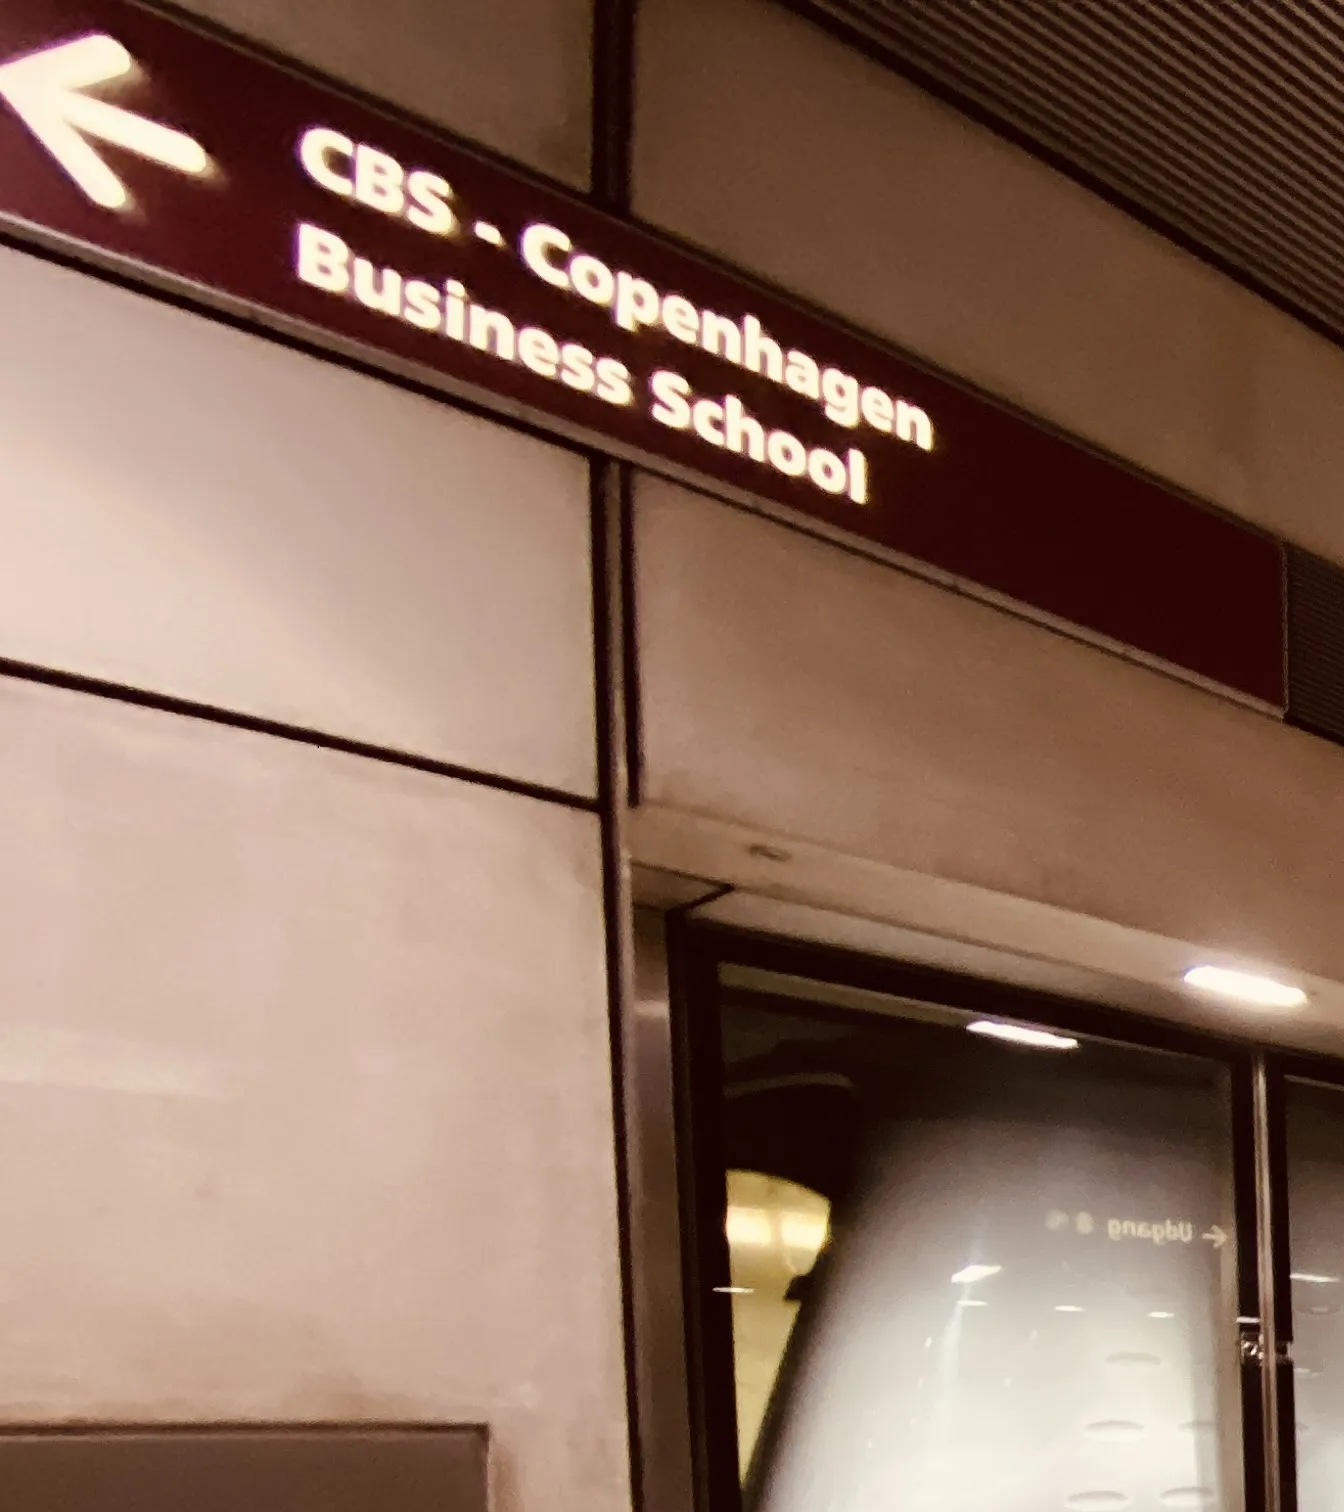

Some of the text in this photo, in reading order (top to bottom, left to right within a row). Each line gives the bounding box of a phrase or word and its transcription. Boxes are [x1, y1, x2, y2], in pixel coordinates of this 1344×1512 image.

[297, 222, 869, 505] Business School
[300, 126, 458, 238] CBS
[520, 222, 935, 453] Copenhagen
